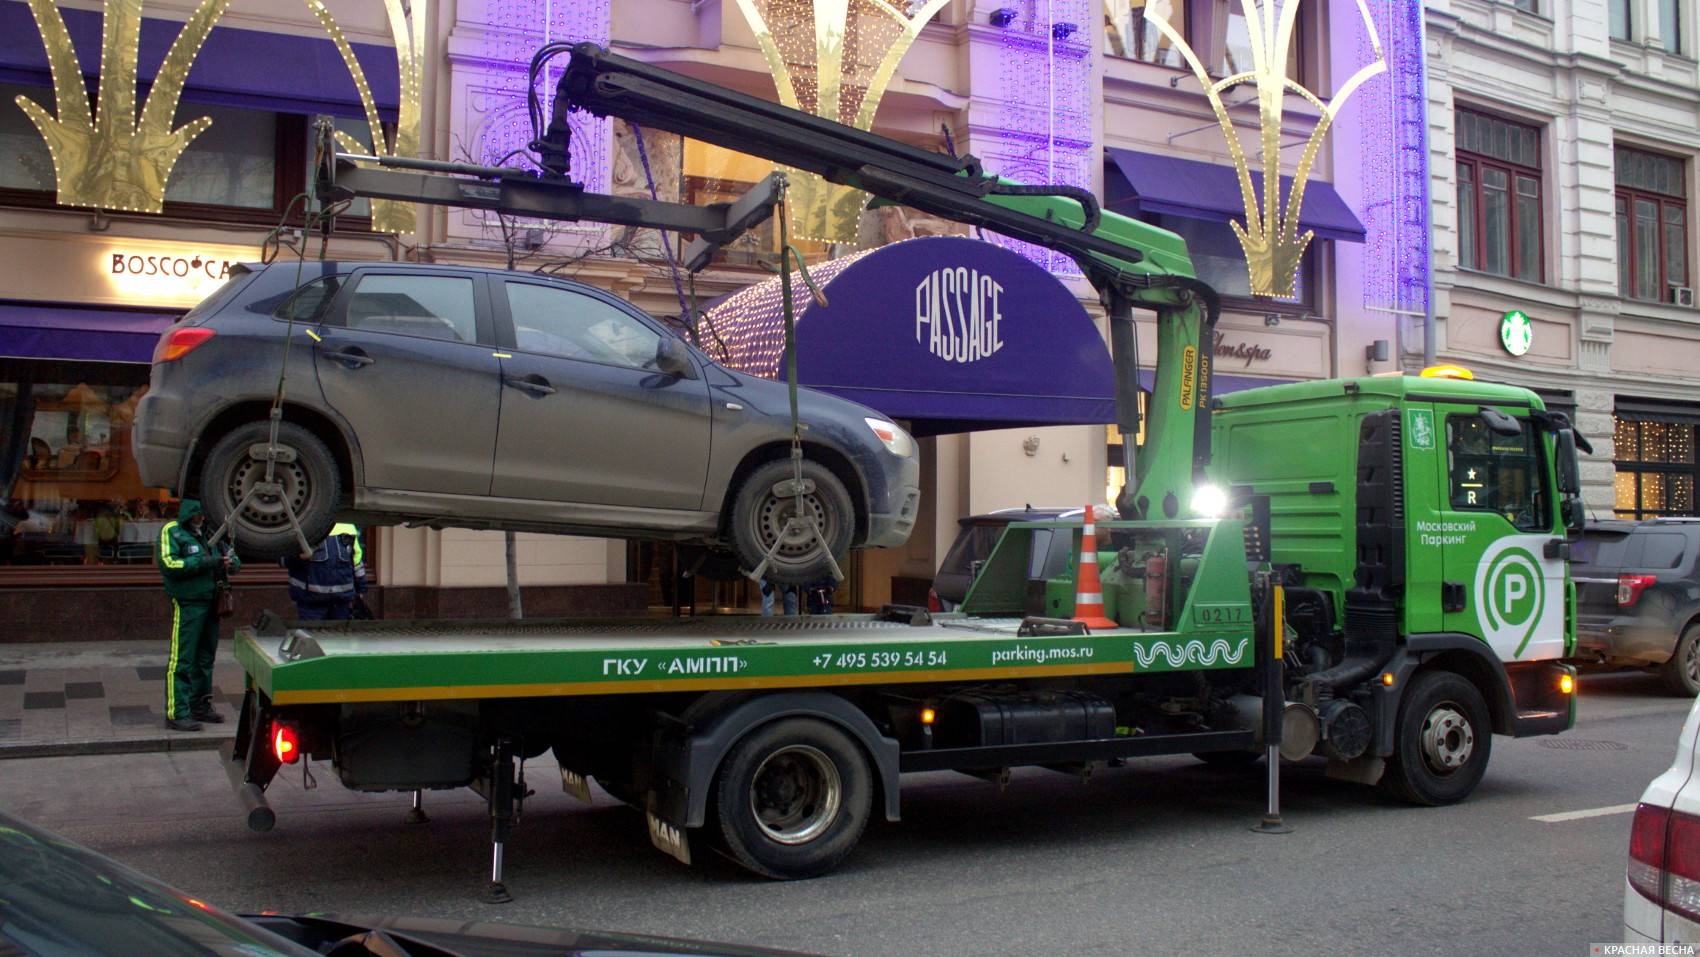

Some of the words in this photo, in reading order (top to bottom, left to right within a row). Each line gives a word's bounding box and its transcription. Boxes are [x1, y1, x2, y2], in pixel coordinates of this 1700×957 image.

[112, 254, 189, 277] BOSCO
[916, 266, 1004, 363] PASSAGE
[1182, 349, 1194, 406] PALFINGER
[1467, 490, 1477, 505] R
[1416, 520, 1476, 532] Московский
[1420, 534, 1467, 547] Паркинг
[1504, 574, 1527, 613] P
[1202, 608, 1241, 622] 0217
[602, 658, 648, 675] ГКУ
[657, 656, 748, 674] «АМПП»
[812, 653, 833, 669] +7
[836, 652, 867, 668] 495
[870, 652, 901, 668] 539
[904, 651, 924, 667] 54
[927, 650, 948, 667] 54
[991, 645, 1094, 666] parking.mos.ru
[650, 815, 681, 849] MAN
